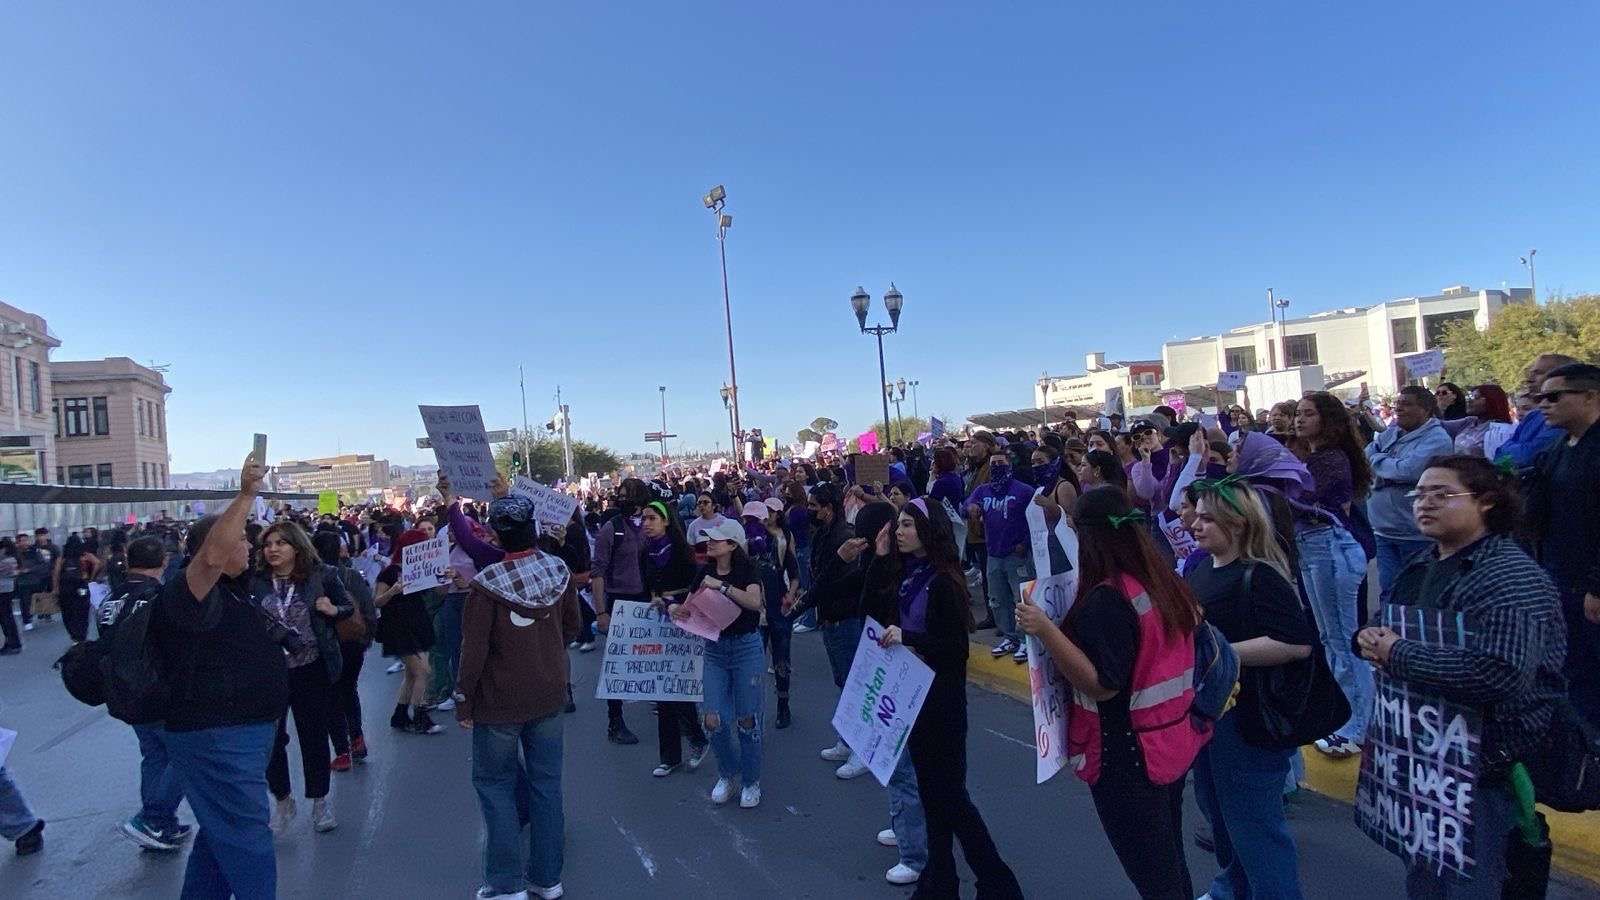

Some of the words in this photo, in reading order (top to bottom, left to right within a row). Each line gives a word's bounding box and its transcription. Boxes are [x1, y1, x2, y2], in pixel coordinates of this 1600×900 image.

[615, 604, 625, 618] A
[607, 642, 630, 656] QUE
[632, 643, 663, 657] MATAR
[605, 661, 620, 675] TE
[624, 660, 675, 674] PREOCUPE
[681, 660, 696, 673] LA
[606, 678, 656, 694] VIOLENCIA
[861, 667, 887, 727] gustan
[878, 695, 896, 728] NO
[1374, 744, 1399, 787] ME
[1408, 757, 1472, 815] HACE
[1376, 789, 1465, 876] MUJER
